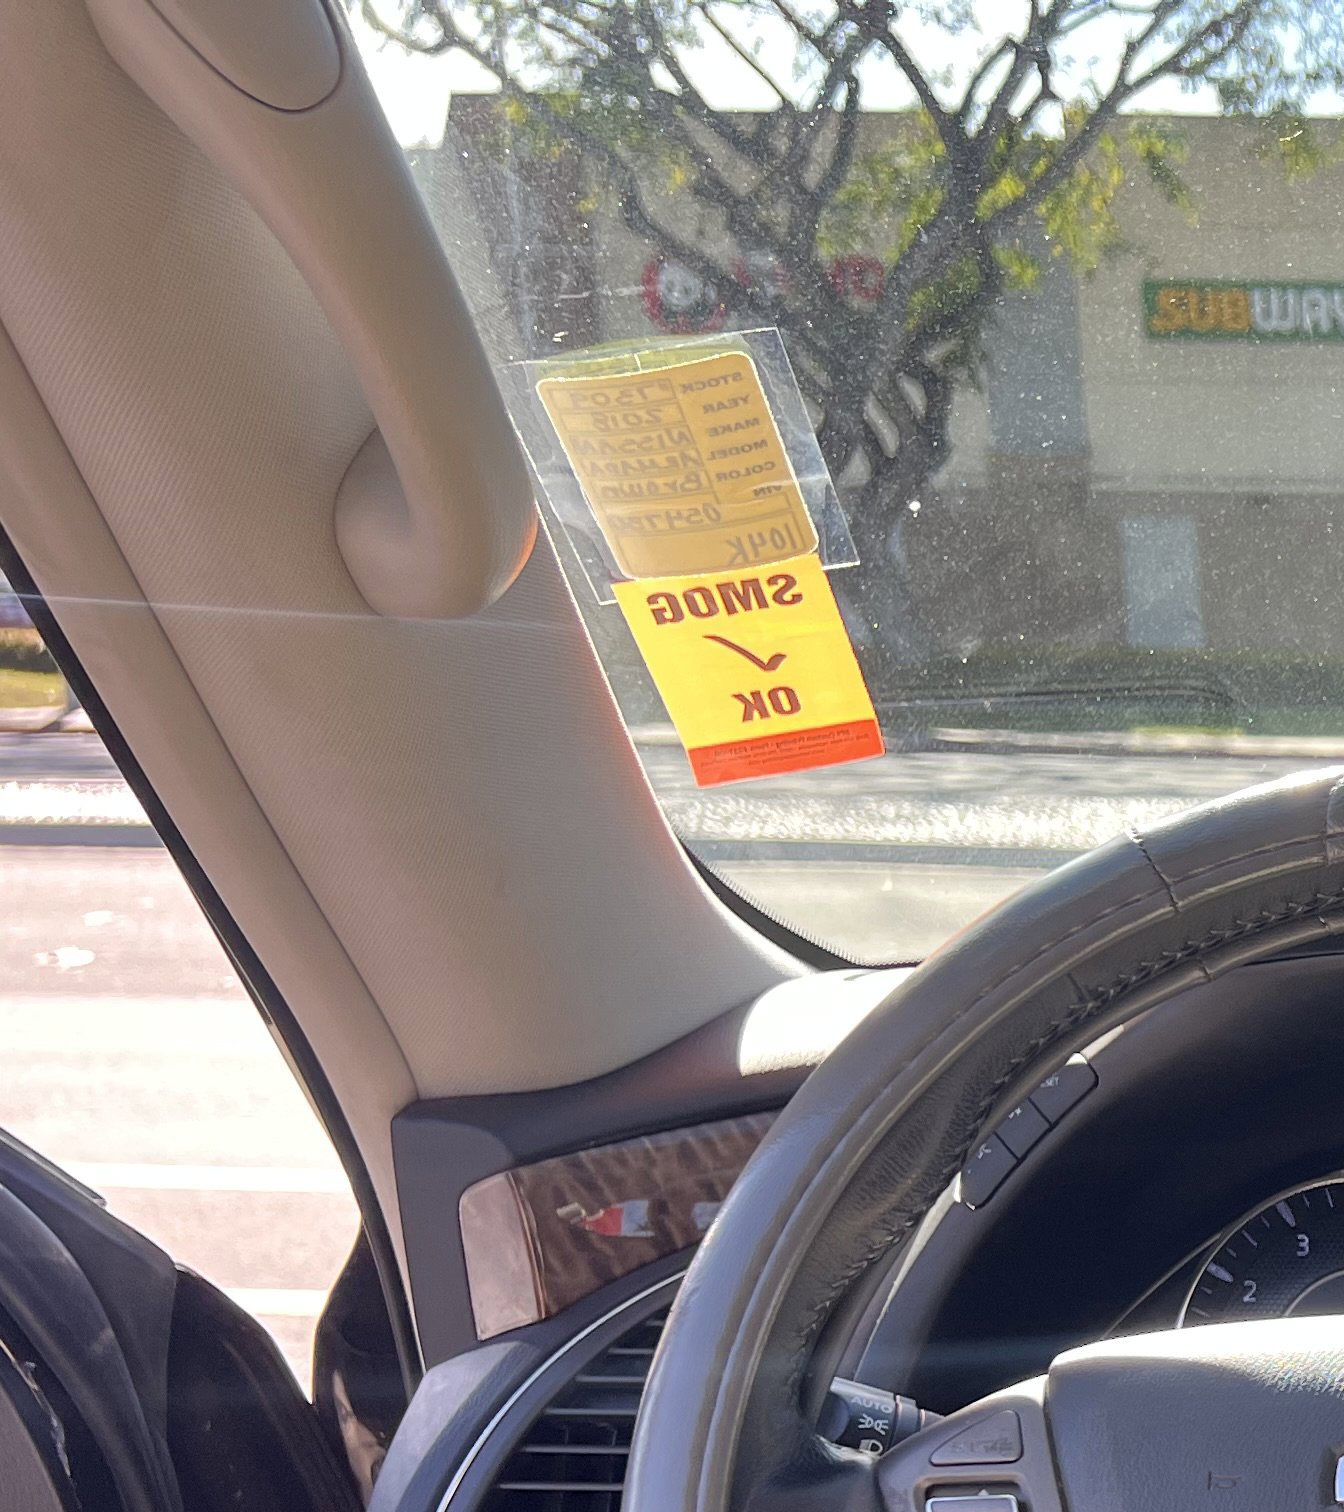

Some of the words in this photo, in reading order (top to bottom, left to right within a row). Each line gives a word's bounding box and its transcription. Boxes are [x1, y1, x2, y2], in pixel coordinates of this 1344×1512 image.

[1296, 1233, 1310, 1257] 3
[1242, 1280, 1257, 1303] 2
[851, 1395, 893, 1414] AUTO
